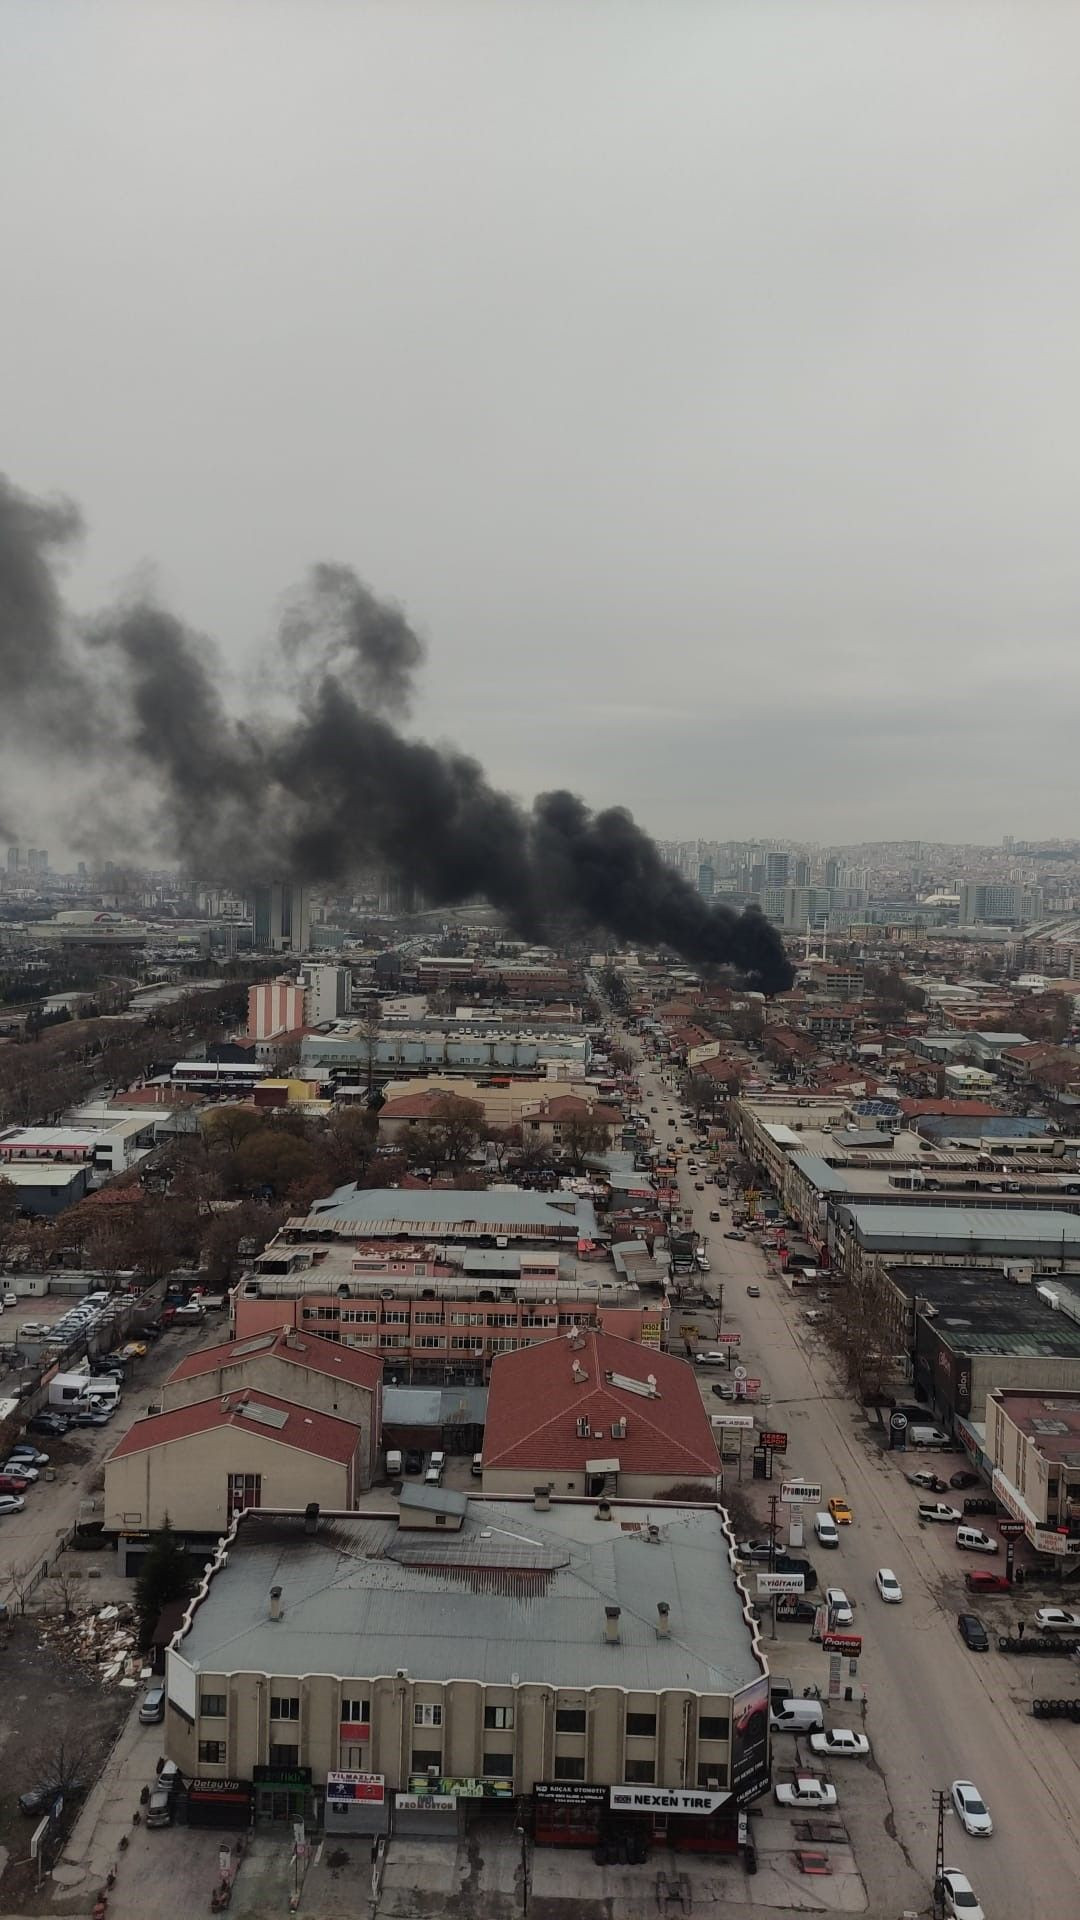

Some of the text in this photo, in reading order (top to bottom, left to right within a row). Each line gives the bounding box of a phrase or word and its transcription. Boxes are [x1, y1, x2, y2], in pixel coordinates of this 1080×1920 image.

[824, 1637, 860, 1647] Pioneer
[634, 1794, 712, 1808] NEXEN TIRE
